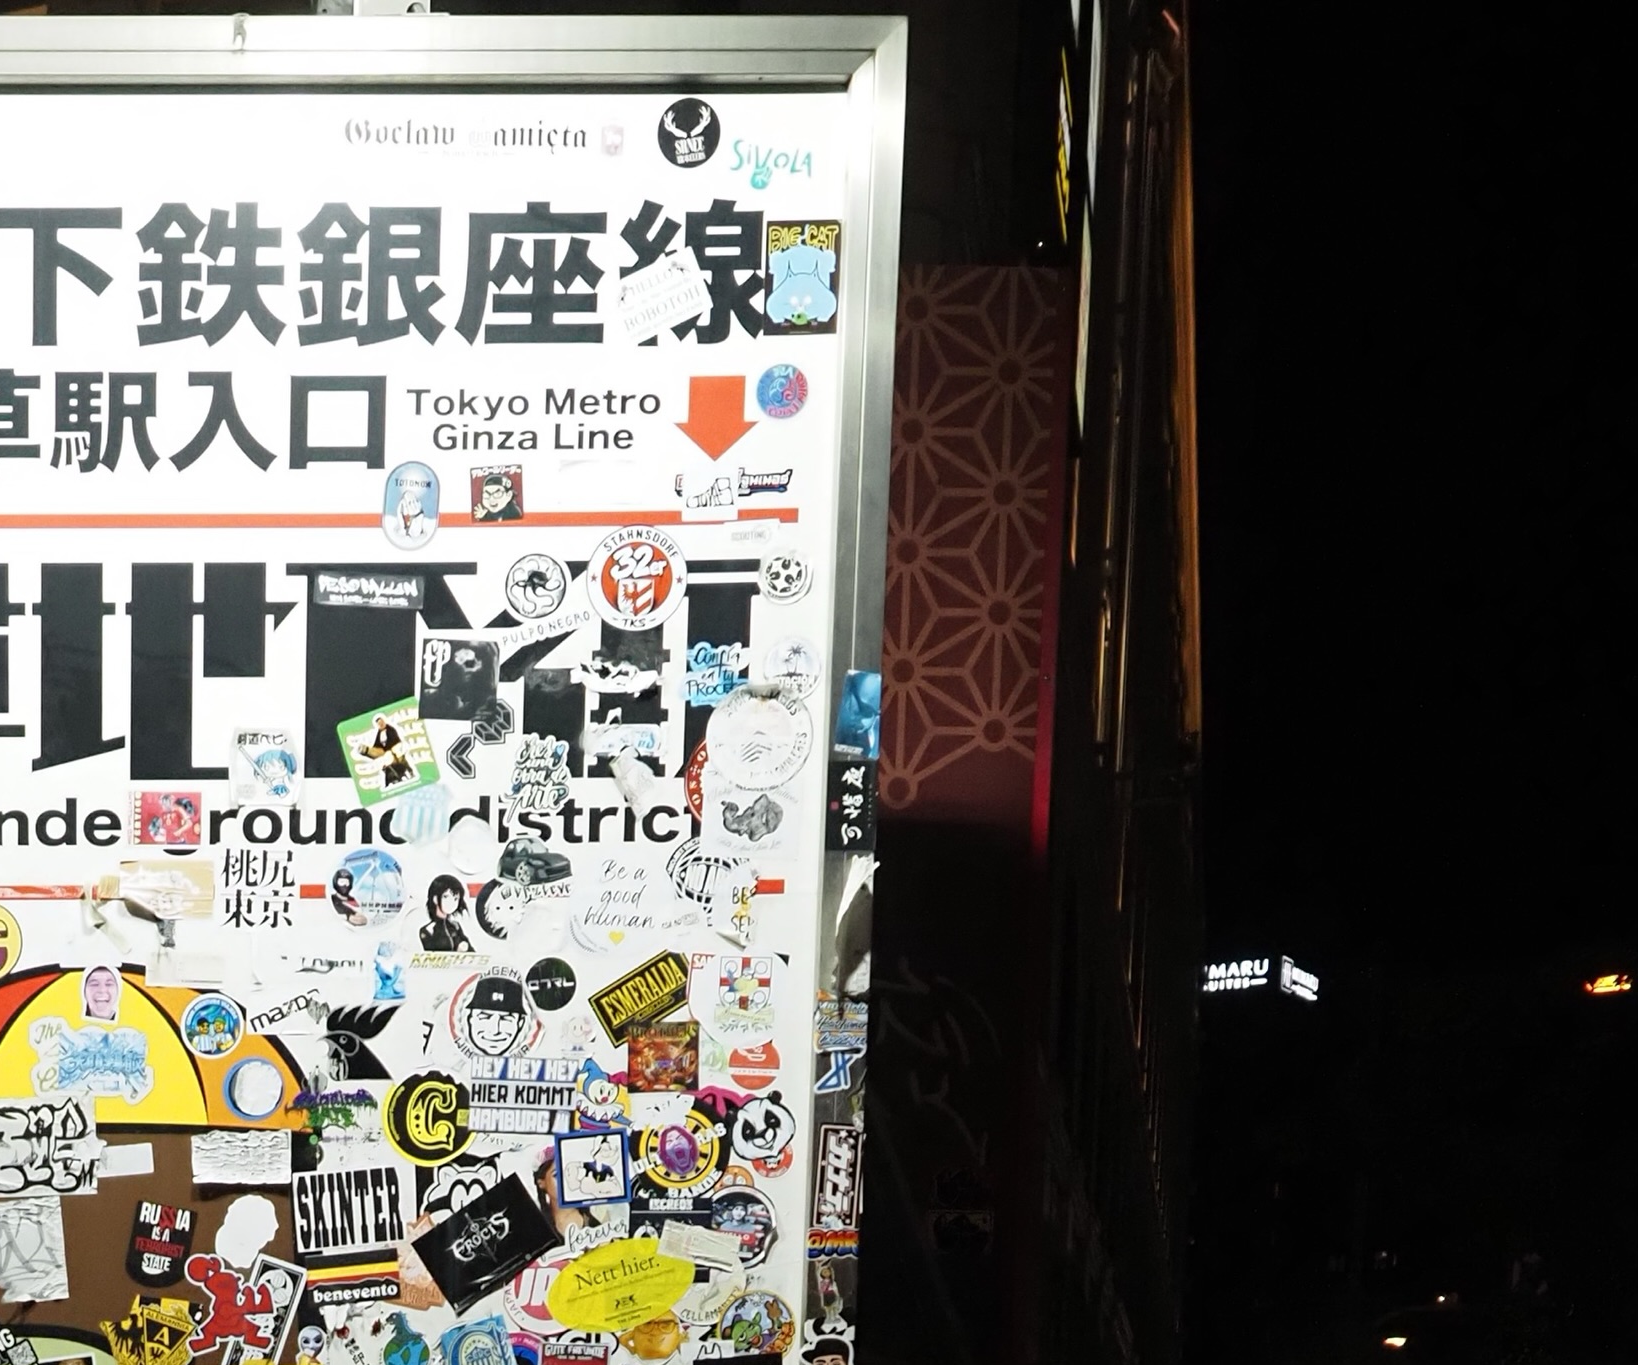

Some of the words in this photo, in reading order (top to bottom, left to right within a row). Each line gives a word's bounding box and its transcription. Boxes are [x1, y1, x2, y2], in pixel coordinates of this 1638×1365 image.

[406, 388, 530, 421] Tokyo
[544, 388, 662, 416] Metro
[432, 423, 538, 451] Ginza
[554, 423, 635, 451] Line
[603, 528, 682, 560] STAHNSDORF
[501, 624, 545, 646] PULPO
[550, 610, 592, 635] NEGRO
[621, 616, 648, 629] TKS
[220, 847, 297, 889] 桃尻
[601, 859, 630, 882] Be
[634, 867, 650, 881] a
[599, 885, 646, 906] good
[219, 889, 296, 929] 東京
[583, 904, 655, 929] human
[411, 952, 491, 967] KNIGHTS
[603, 962, 686, 1026] ESMERALDA
[629, 1022, 700, 1038] BROTHERS
[472, 1058, 499, 1079] HEY
[509, 1058, 540, 1079] HEY
[546, 1058, 578, 1079] HEY
[471, 1084, 510, 1104] HIER
[514, 1084, 576, 1106] KOMMT
[468, 1109, 551, 1133] HAMBURG
[139, 1201, 191, 1232] RUSSIA
[296, 1166, 404, 1252] SKINTER
[565, 1219, 629, 1254] forever
[141, 1253, 171, 1272] STATE
[574, 1262, 622, 1292] Nett
[624, 1254, 661, 1281] hier.
[312, 1282, 399, 1303] benevento
